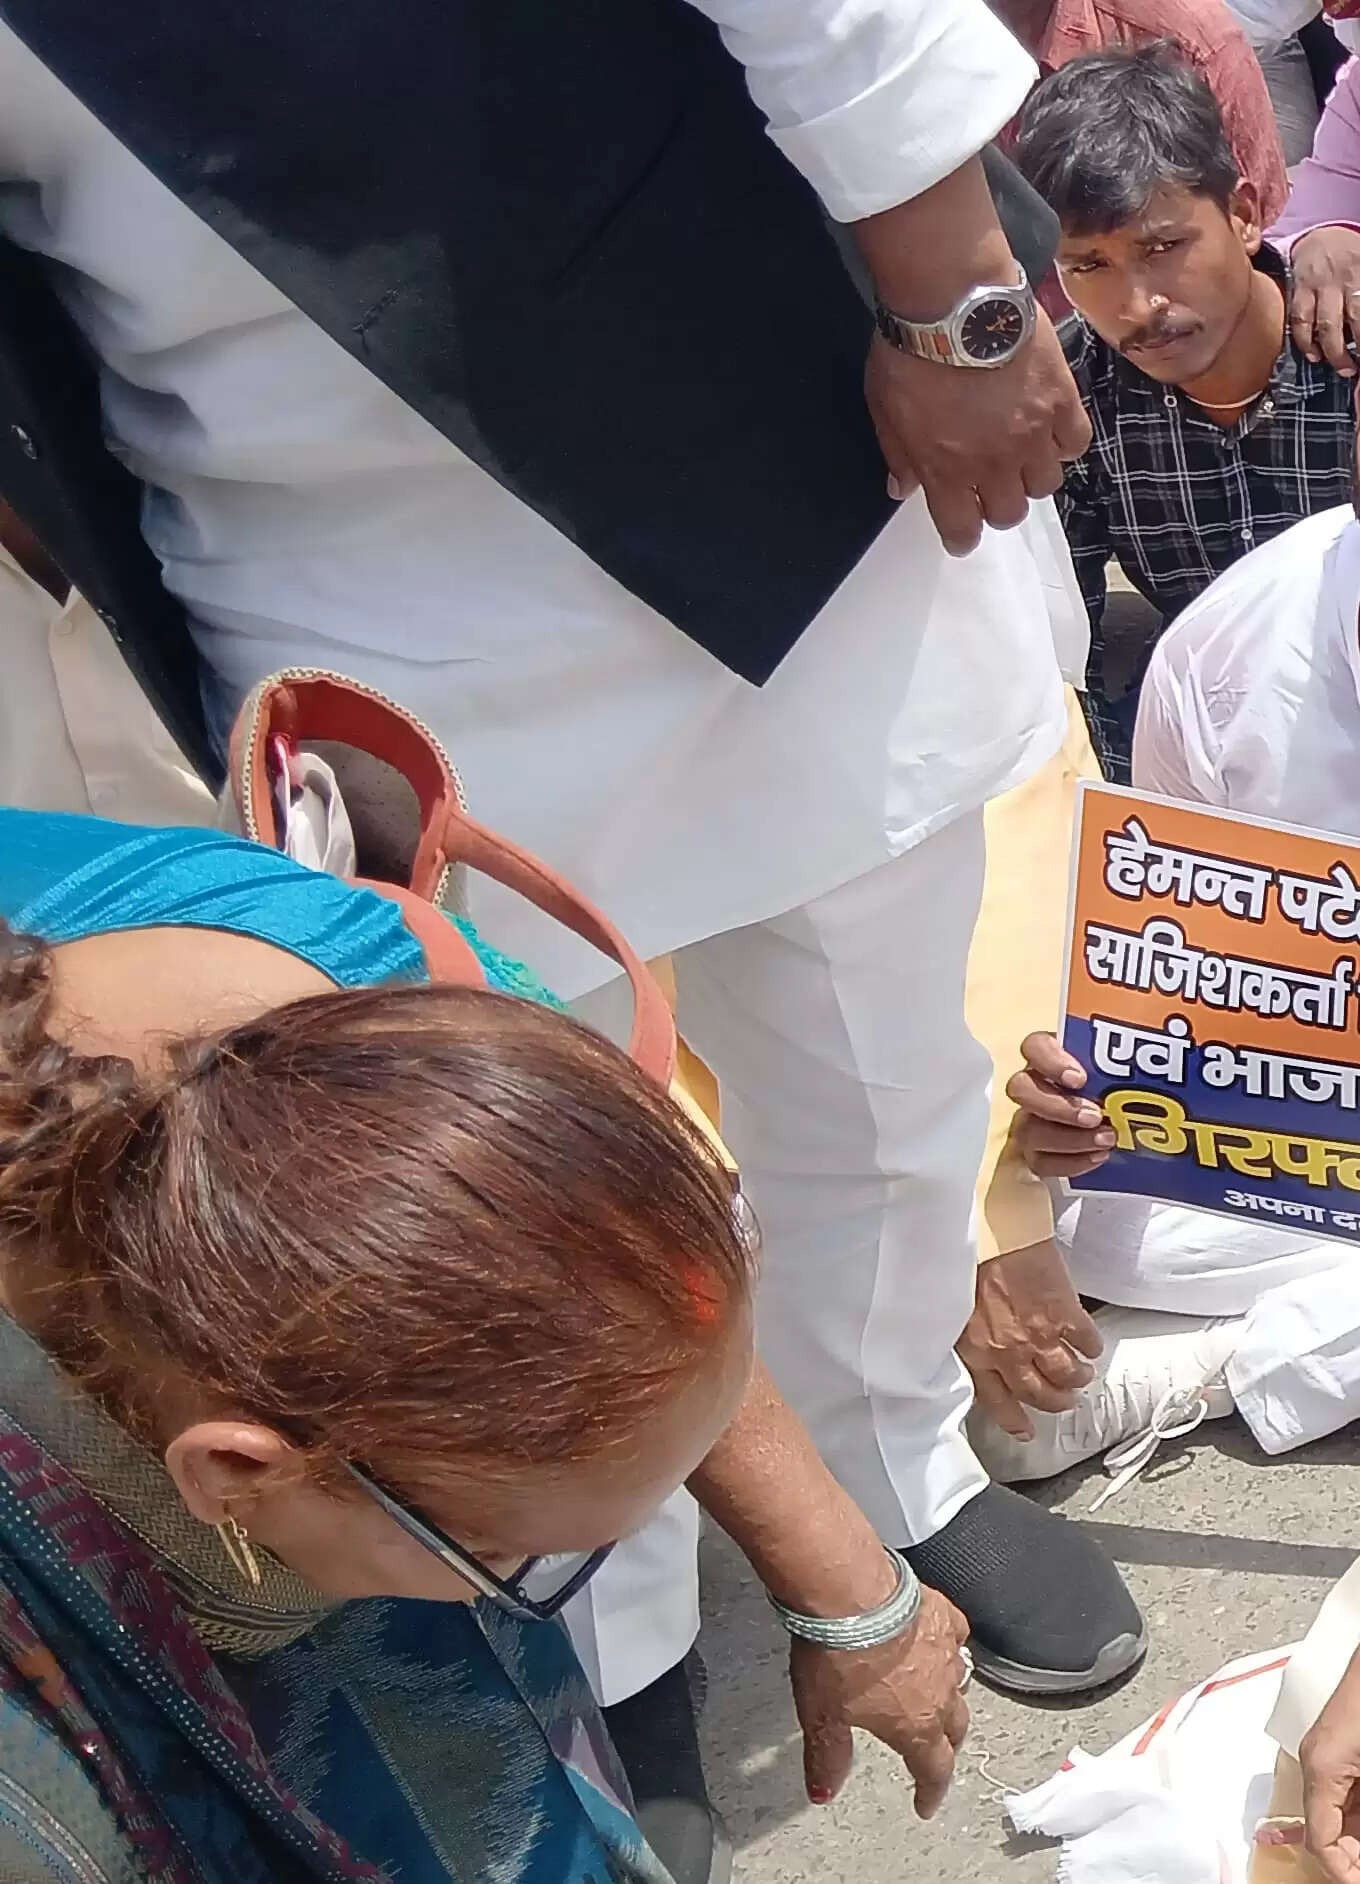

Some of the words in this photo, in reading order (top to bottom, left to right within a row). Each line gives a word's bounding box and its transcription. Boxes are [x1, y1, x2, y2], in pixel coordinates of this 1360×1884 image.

[1104, 822, 1272, 916] हेमन्त
[1086, 921, 1354, 1027] साजिशकर्ता
[1092, 1021, 1190, 1084] एवं
[1223, 1188, 1326, 1224] अपना
